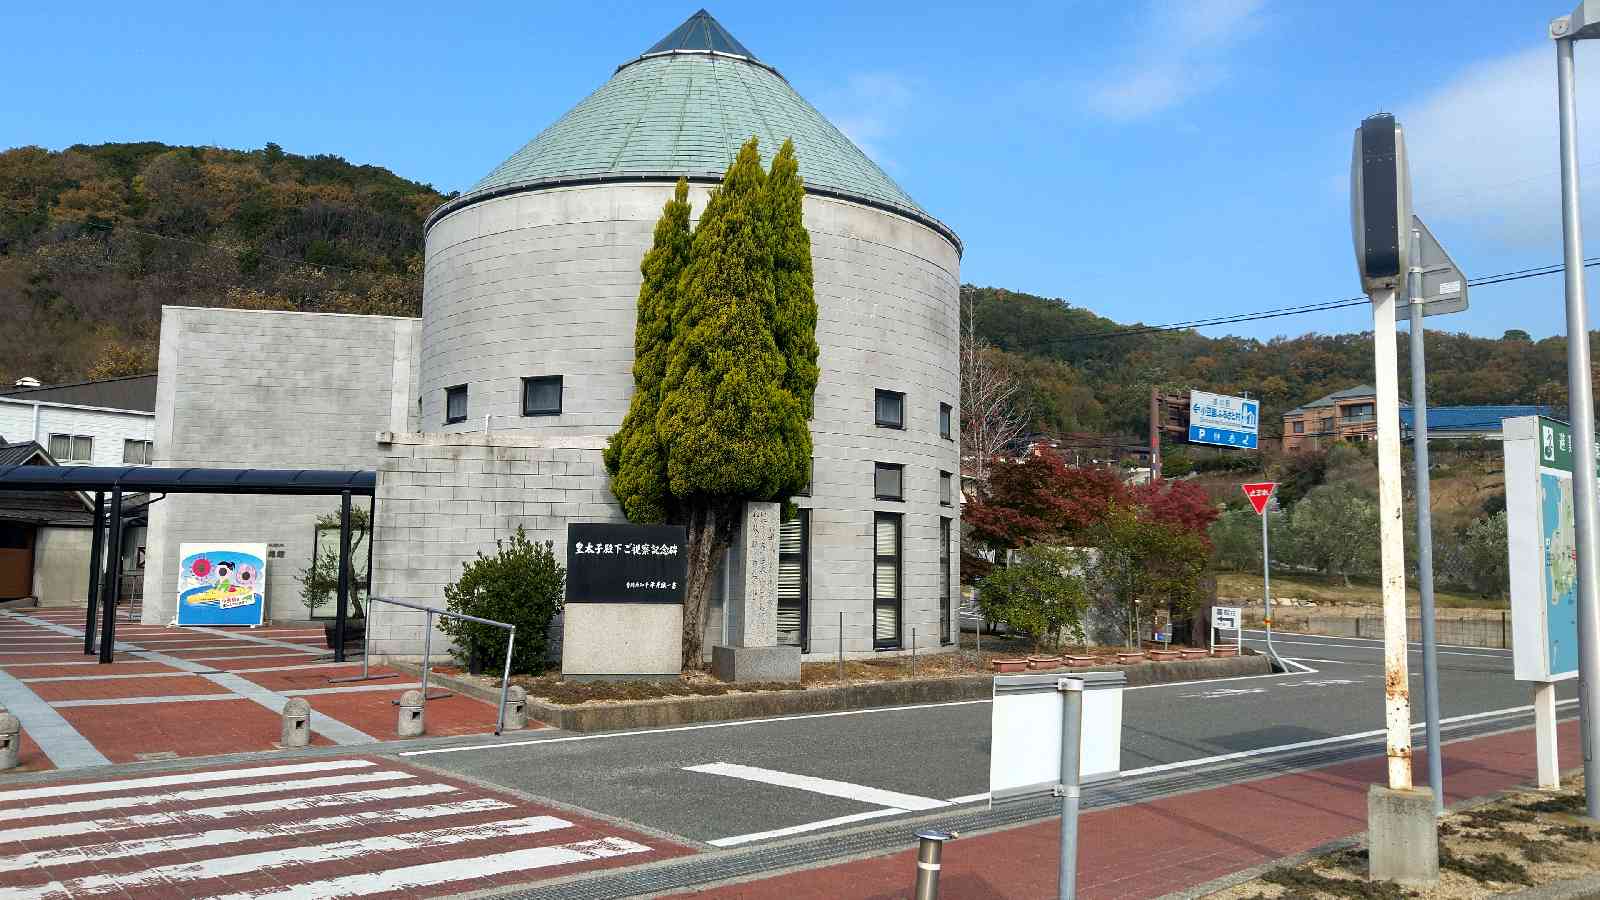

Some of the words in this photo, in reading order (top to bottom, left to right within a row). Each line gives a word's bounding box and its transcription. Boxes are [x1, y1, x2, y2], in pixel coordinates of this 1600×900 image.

[575, 541, 679, 556] 皇太子殿下ご視察記念碑
